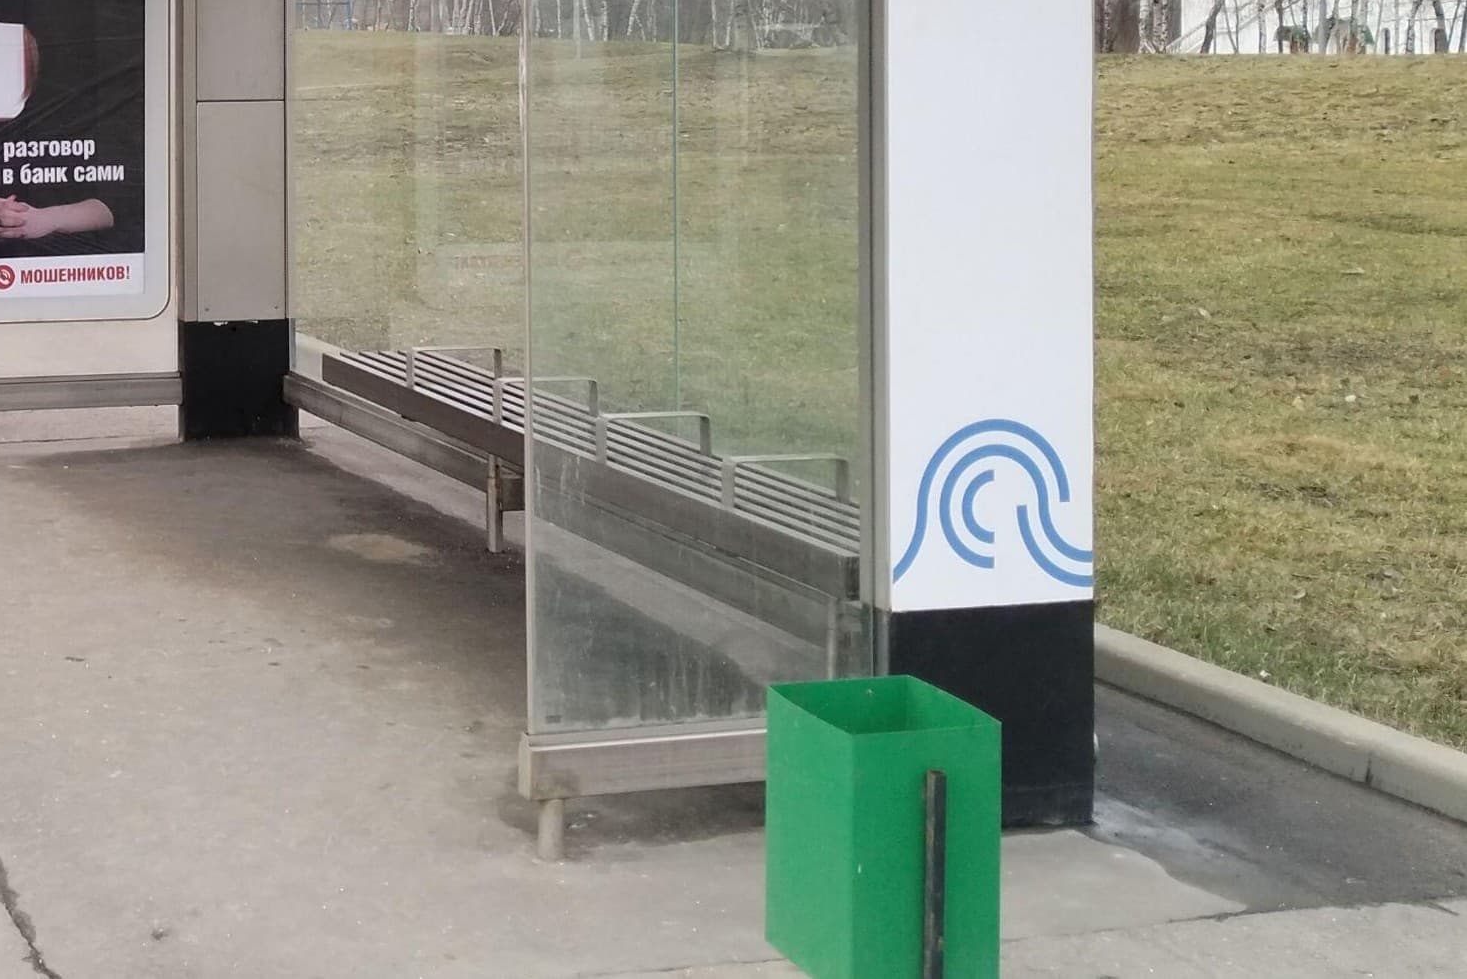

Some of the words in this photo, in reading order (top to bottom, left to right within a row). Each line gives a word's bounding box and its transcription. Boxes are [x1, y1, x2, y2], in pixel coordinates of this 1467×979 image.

[3, 139, 96, 163] разговор
[2, 168, 14, 185] в
[20, 163, 68, 184] банк
[73, 164, 125, 183] сами
[20, 266, 131, 285] МОШЕННИКОВ!
